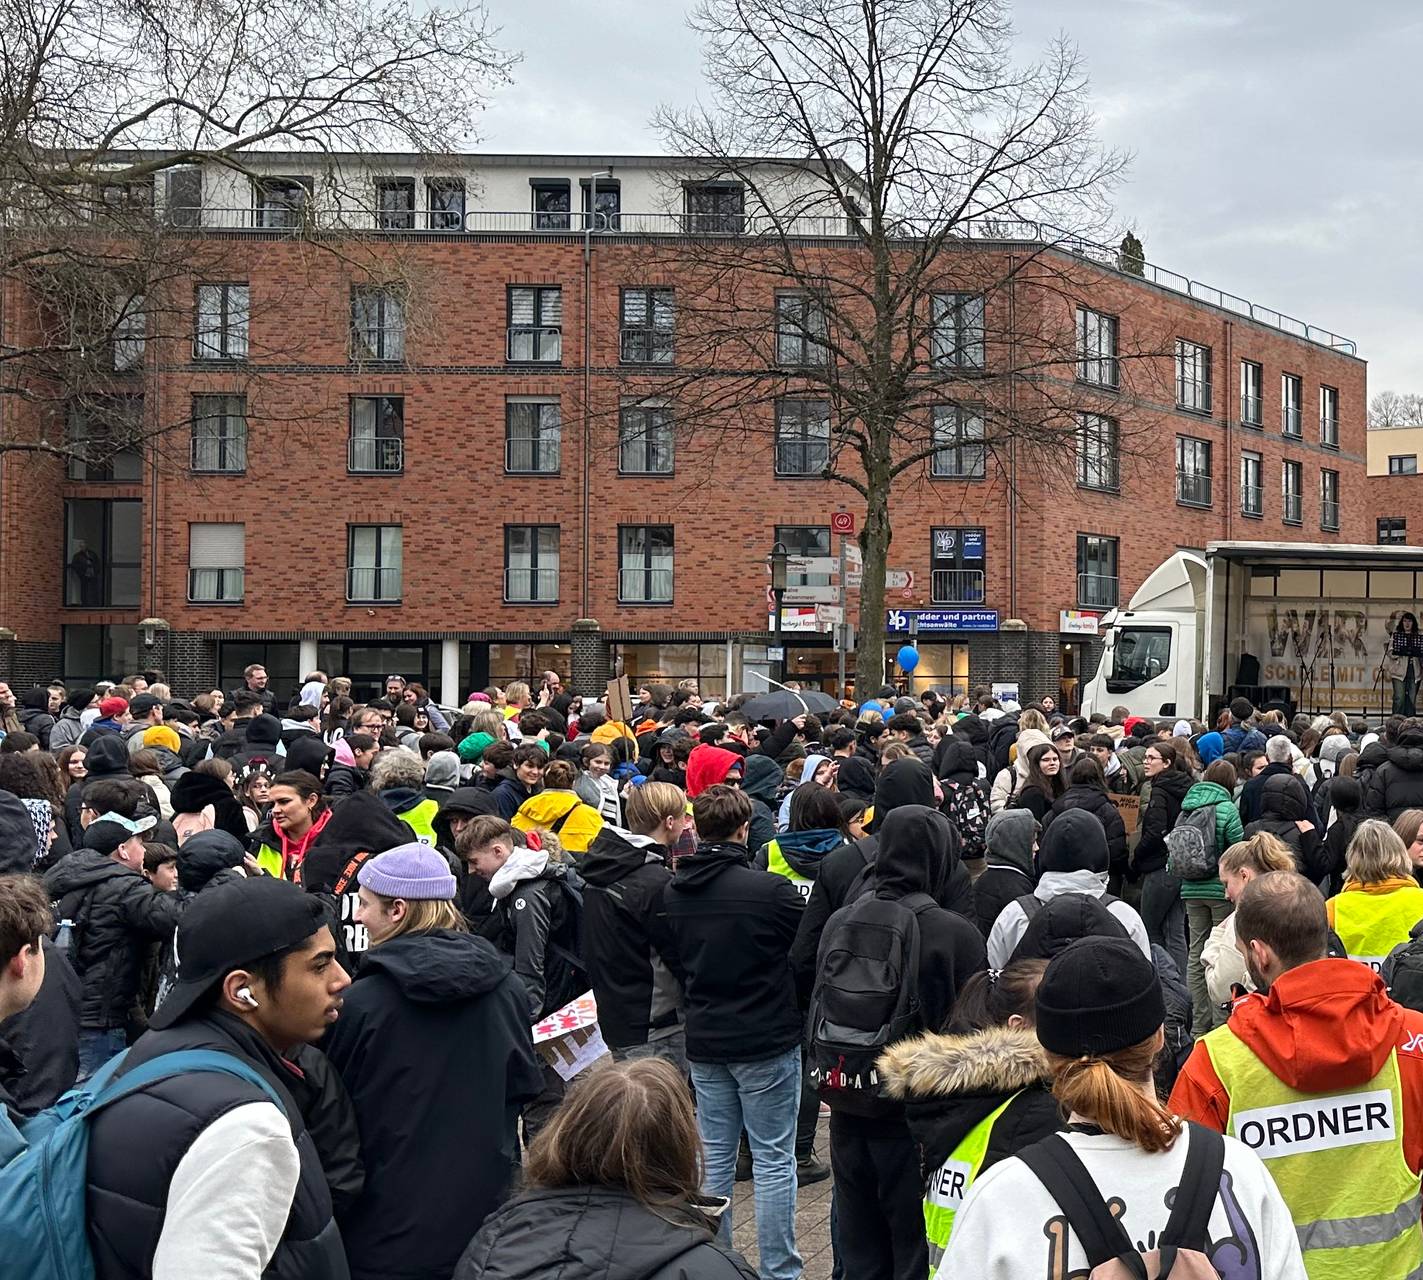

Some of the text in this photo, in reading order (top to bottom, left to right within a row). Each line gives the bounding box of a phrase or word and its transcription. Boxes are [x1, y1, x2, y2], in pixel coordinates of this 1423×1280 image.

[943, 613, 959, 621] und
[962, 613, 996, 622] partner
[1267, 609, 1369, 659] WIR
[1264, 664, 1330, 682] SCHLE
[1337, 665, 1366, 683] MIT
[1240, 1102, 1390, 1149] ORDNER
[931, 1167, 966, 1200] NER
